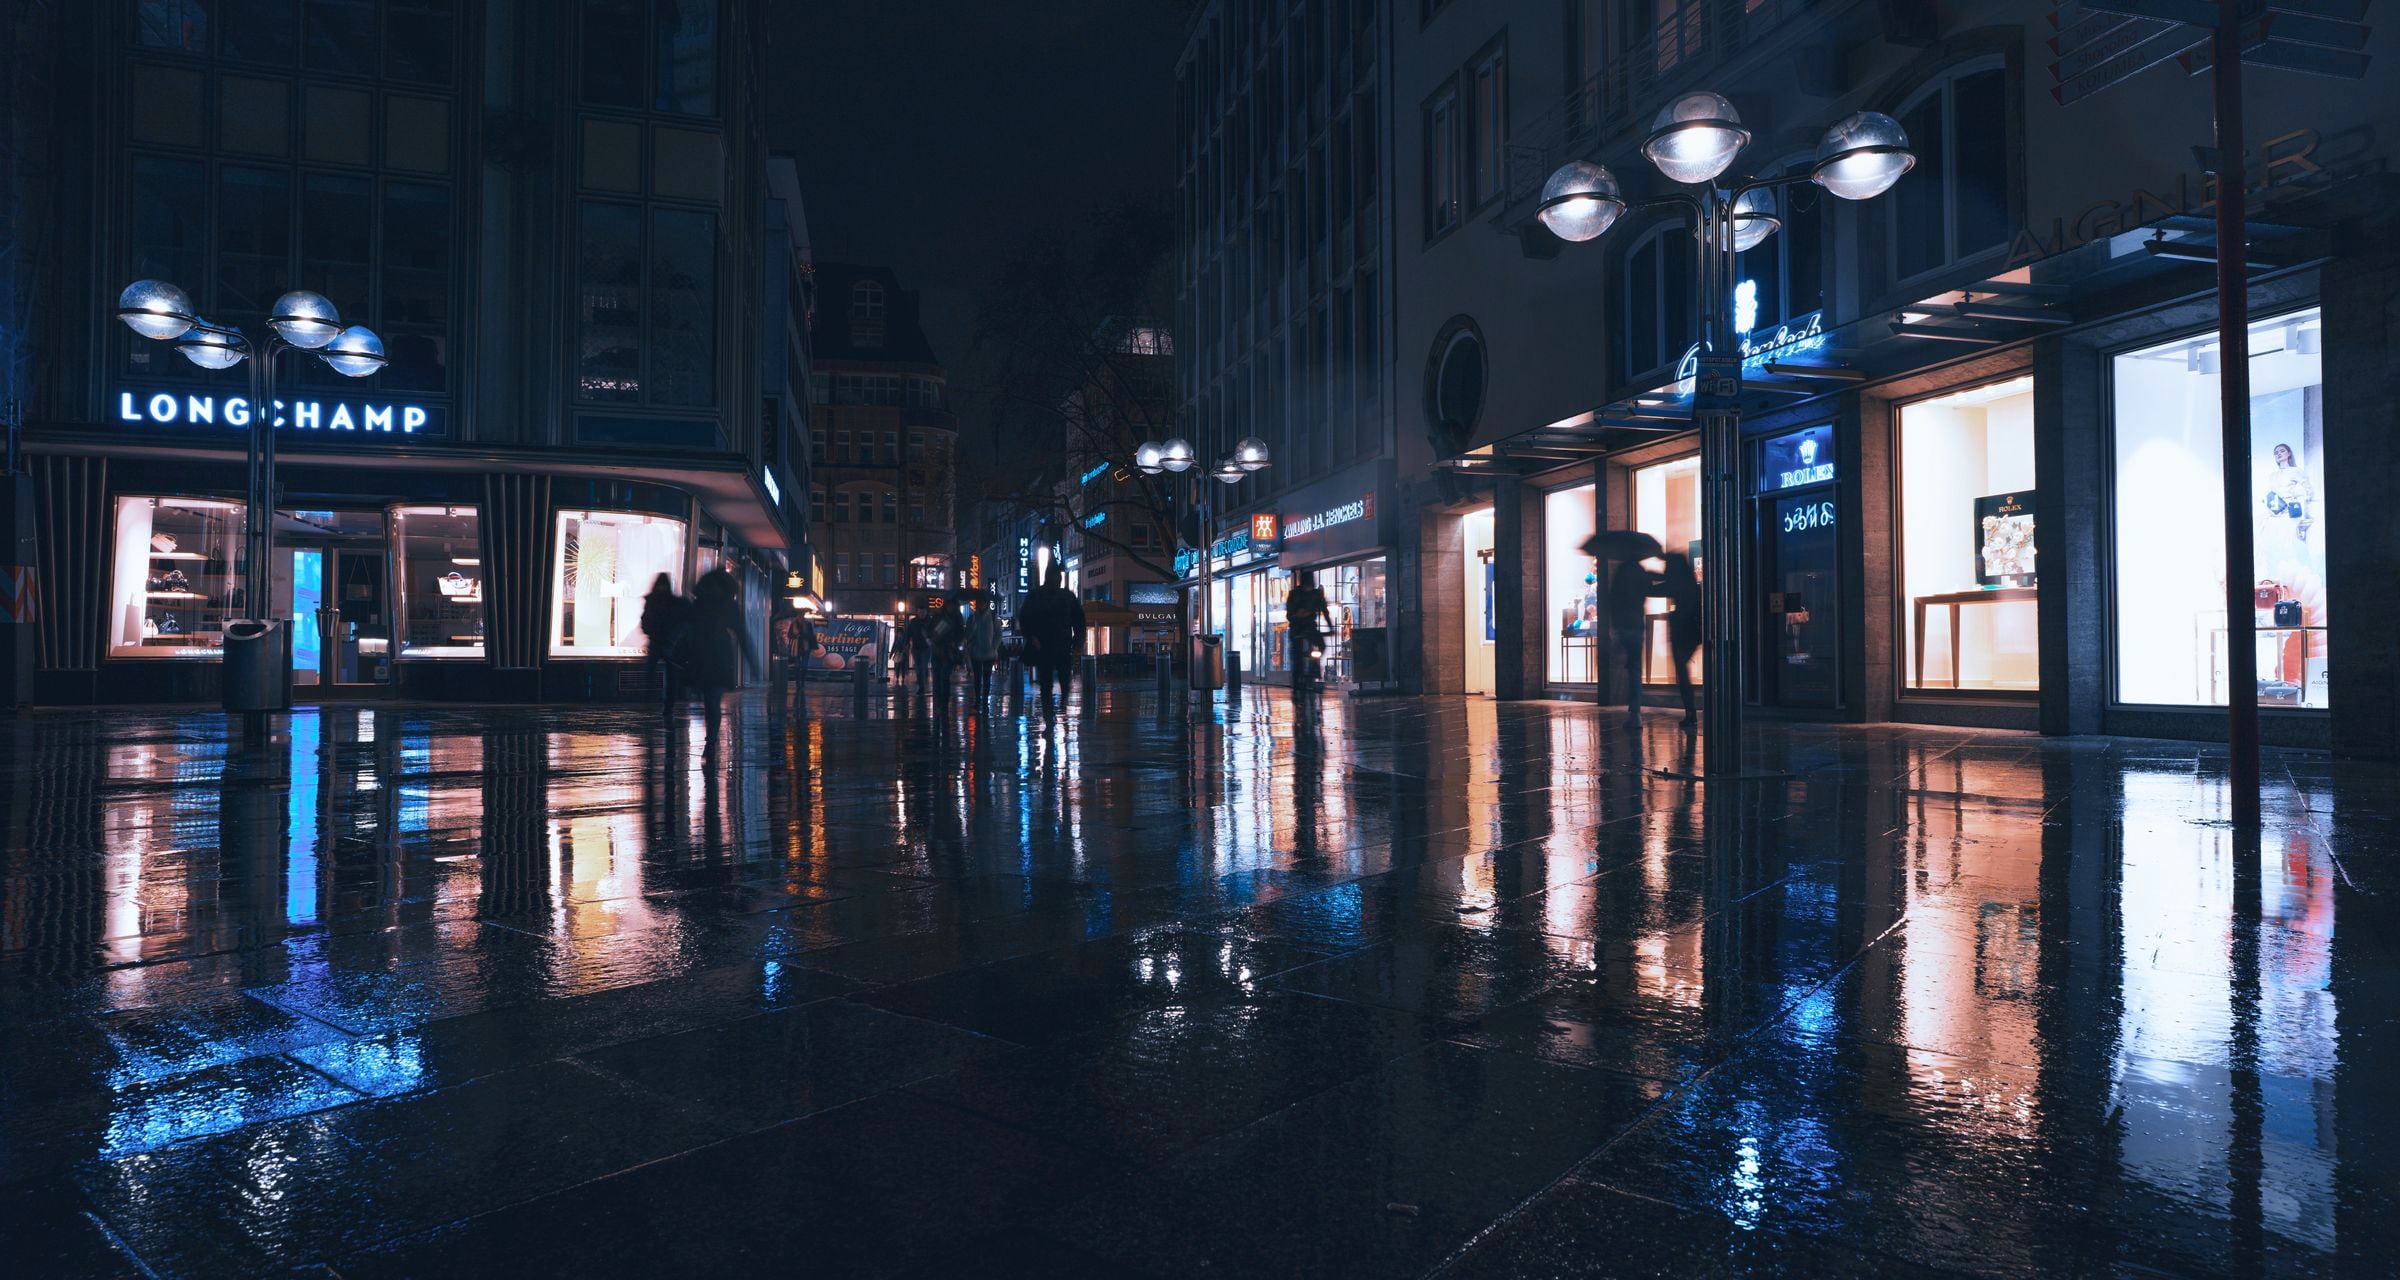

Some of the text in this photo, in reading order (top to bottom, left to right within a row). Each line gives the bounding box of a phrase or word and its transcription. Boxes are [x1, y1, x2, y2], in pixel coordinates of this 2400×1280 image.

[2077, 52, 2146, 92] KOLUMBA
[121, 392, 427, 433] LONGCHAMP
[1781, 463, 1834, 488] ROLEX
[1284, 517, 1312, 539] ZWILLING
[1326, 500, 1364, 526] HENCKELS
[1998, 504, 2022, 513] ROLEX
[1020, 537, 1029, 588] HOTEL
[815, 633, 870, 645] Berliner
